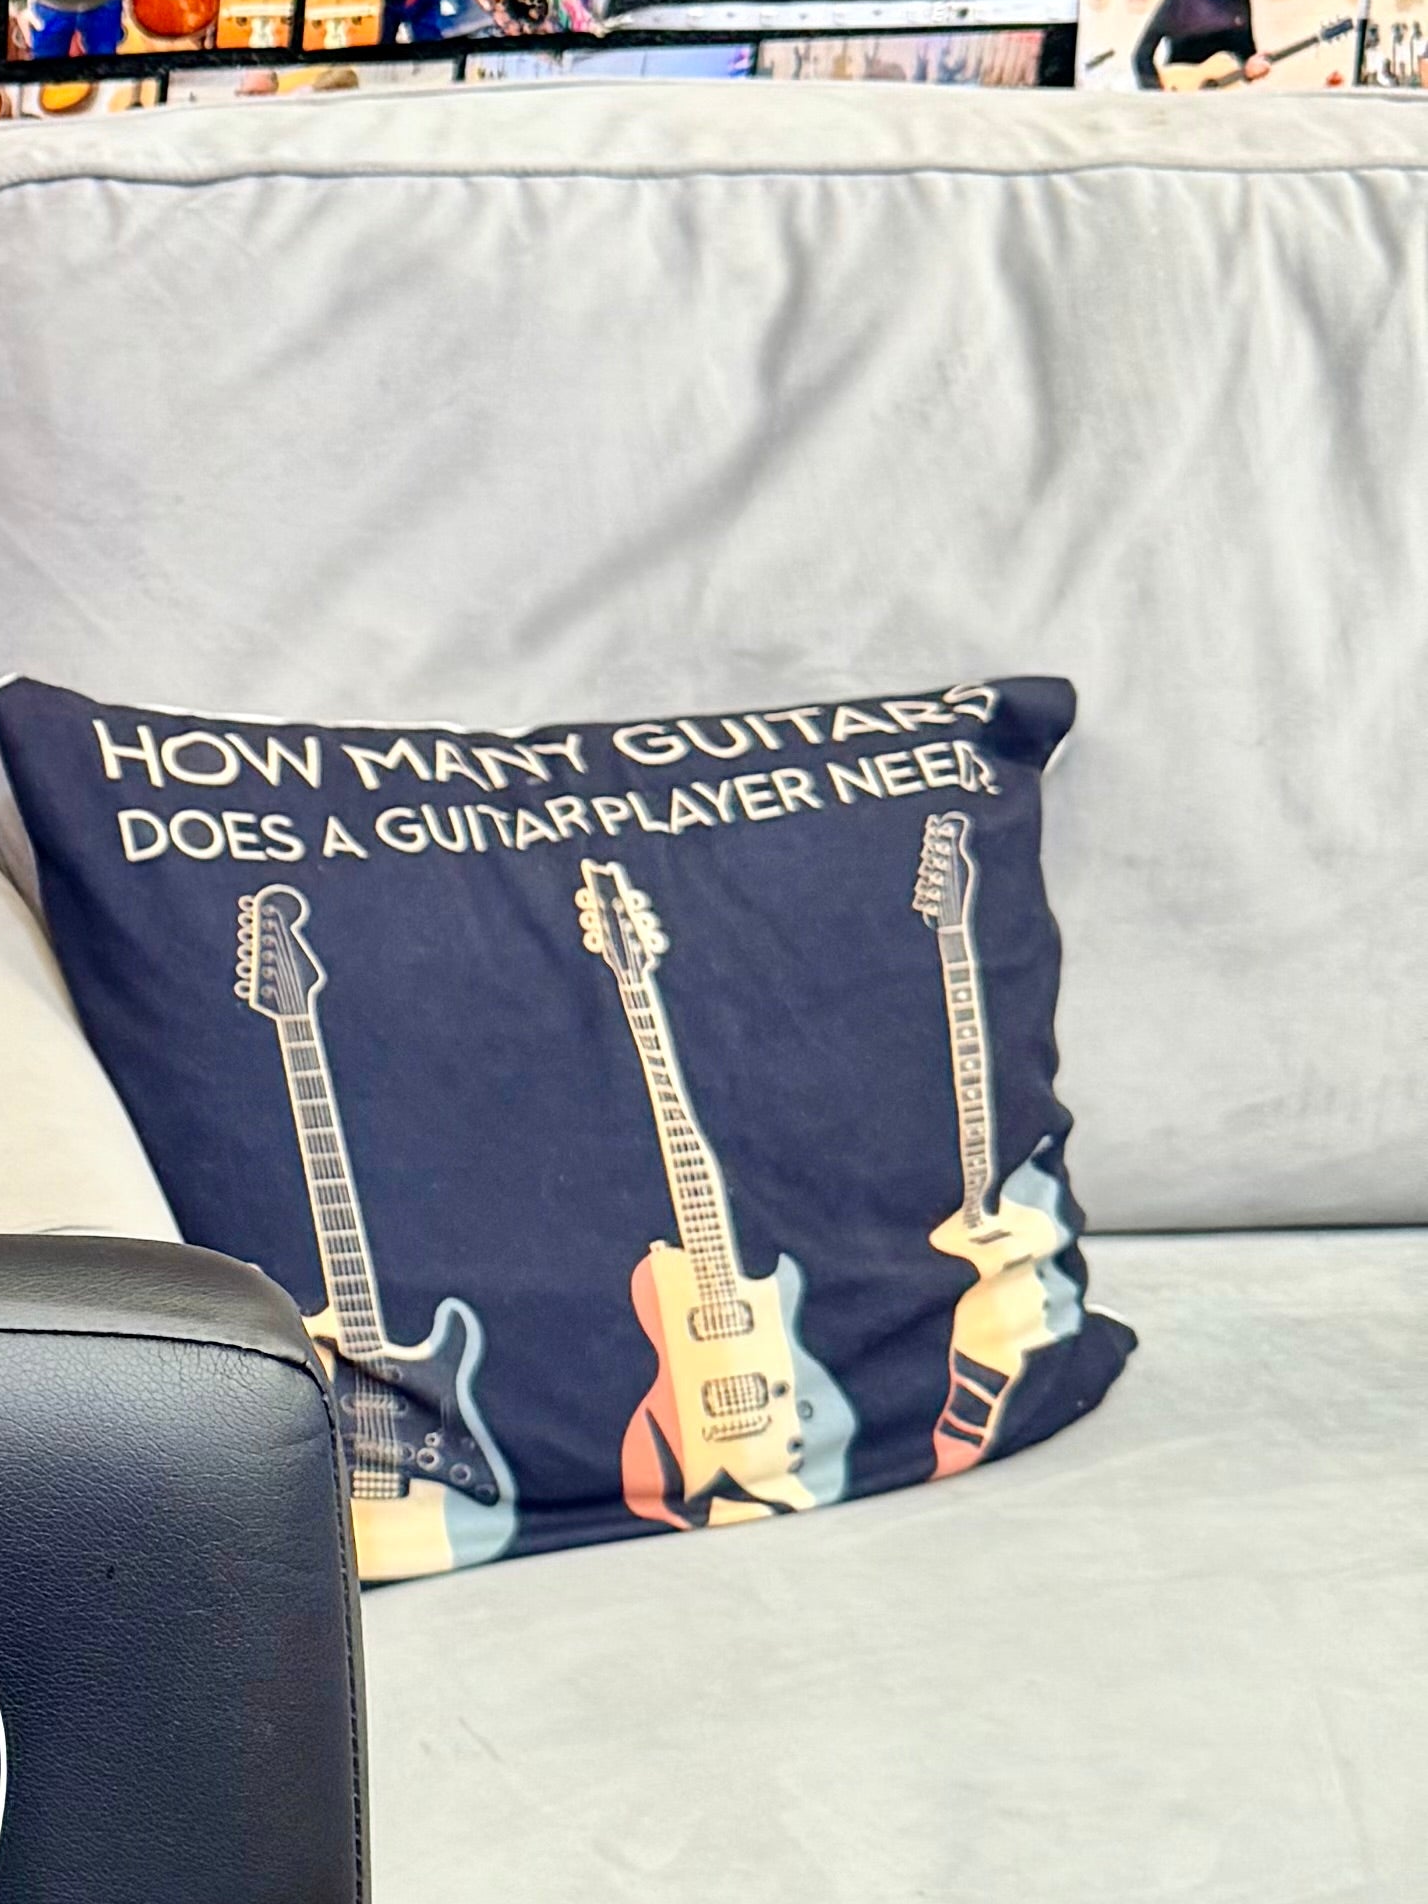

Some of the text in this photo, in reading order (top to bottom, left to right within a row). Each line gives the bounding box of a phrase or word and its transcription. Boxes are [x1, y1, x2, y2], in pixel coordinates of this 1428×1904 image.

[92, 683, 1001, 793] HOW MANY GUITARS
[117, 808, 306, 863] DOES
[323, 815, 370, 860] A
